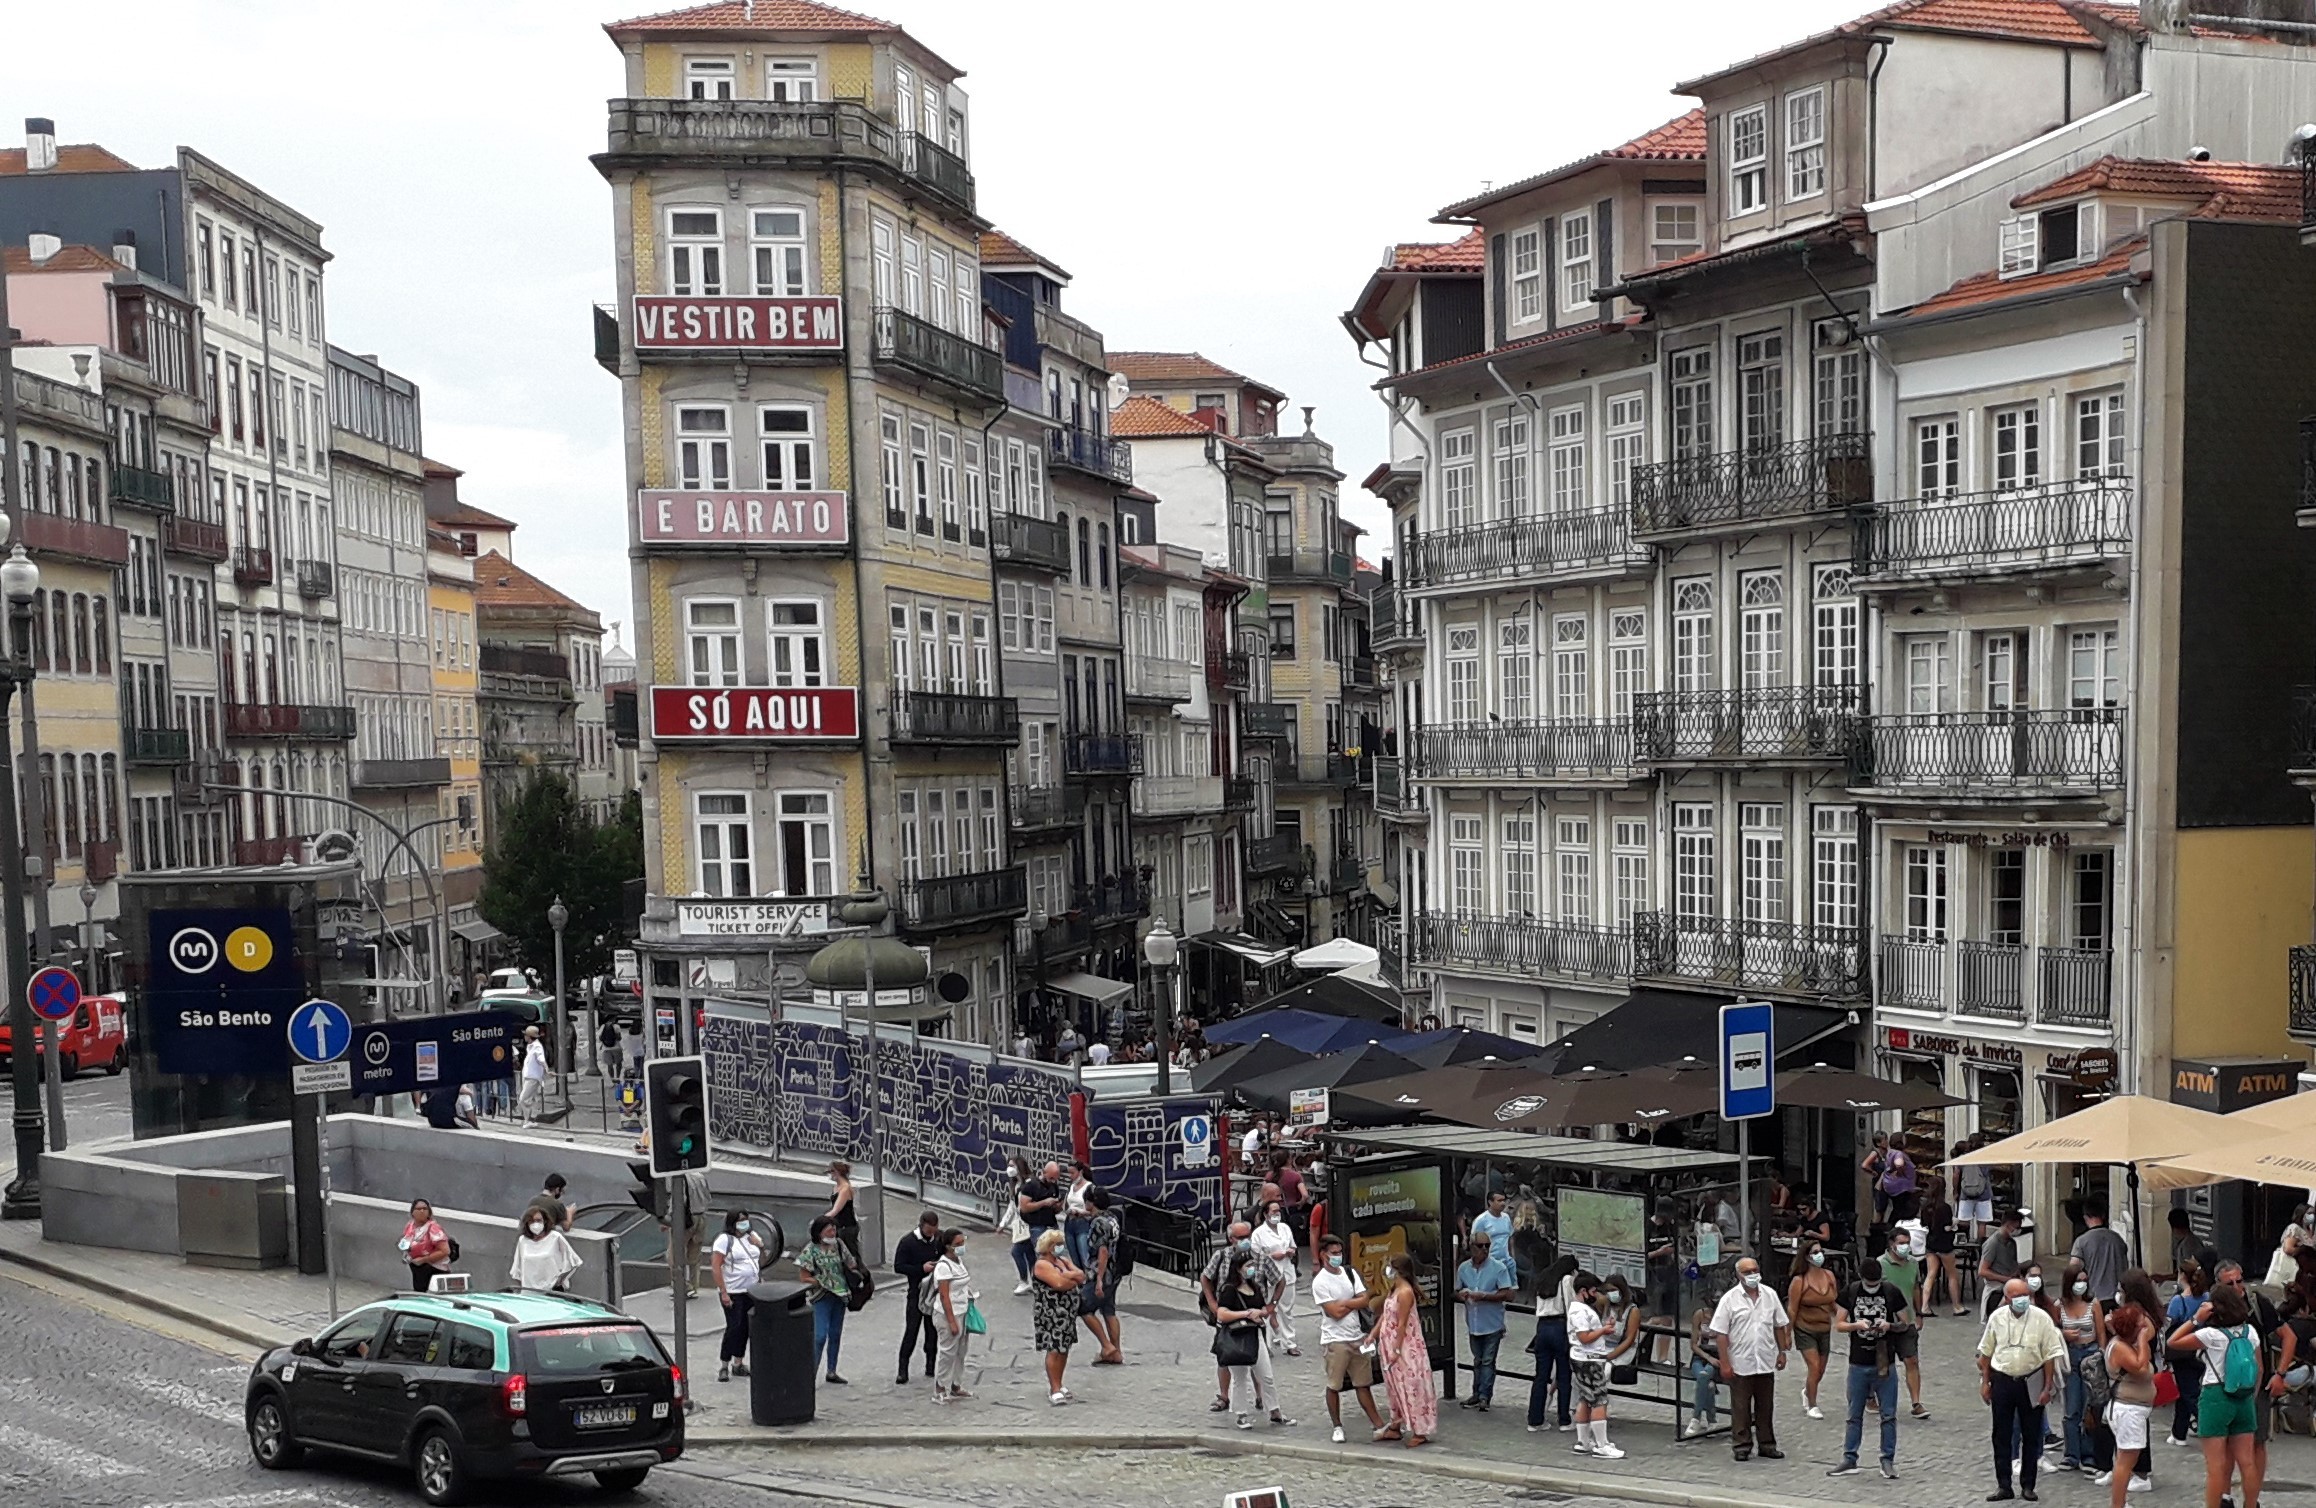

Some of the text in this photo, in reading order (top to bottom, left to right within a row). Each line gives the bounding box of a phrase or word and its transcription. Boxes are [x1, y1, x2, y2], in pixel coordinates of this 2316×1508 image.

[638, 305, 836, 340] VESTIR BEM
[657, 499, 830, 534] E BARATO
[688, 690, 821, 731] SÓ AQUI
[1928, 830, 2070, 848] Restaurante Salão de Chá
[684, 905, 822, 920] TOURIST SERVCE
[707, 922, 803, 934] TICKET OFFI
[243, 942, 256, 957] D
[180, 1010, 272, 1027] São Bento
[452, 1026, 504, 1043] São Bento
[1913, 1033, 1960, 1055] SABORES
[1982, 1042, 2022, 1063] Invicta
[363, 1067, 393, 1080] metro
[790, 1067, 816, 1086] Porto.
[2176, 1070, 2214, 1094] ATM
[2238, 1073, 2287, 1094] ATM
[865, 1083, 891, 1104] Pto.
[992, 1113, 1024, 1136] Porto.
[1353, 1197, 1416, 1218] cada momento
